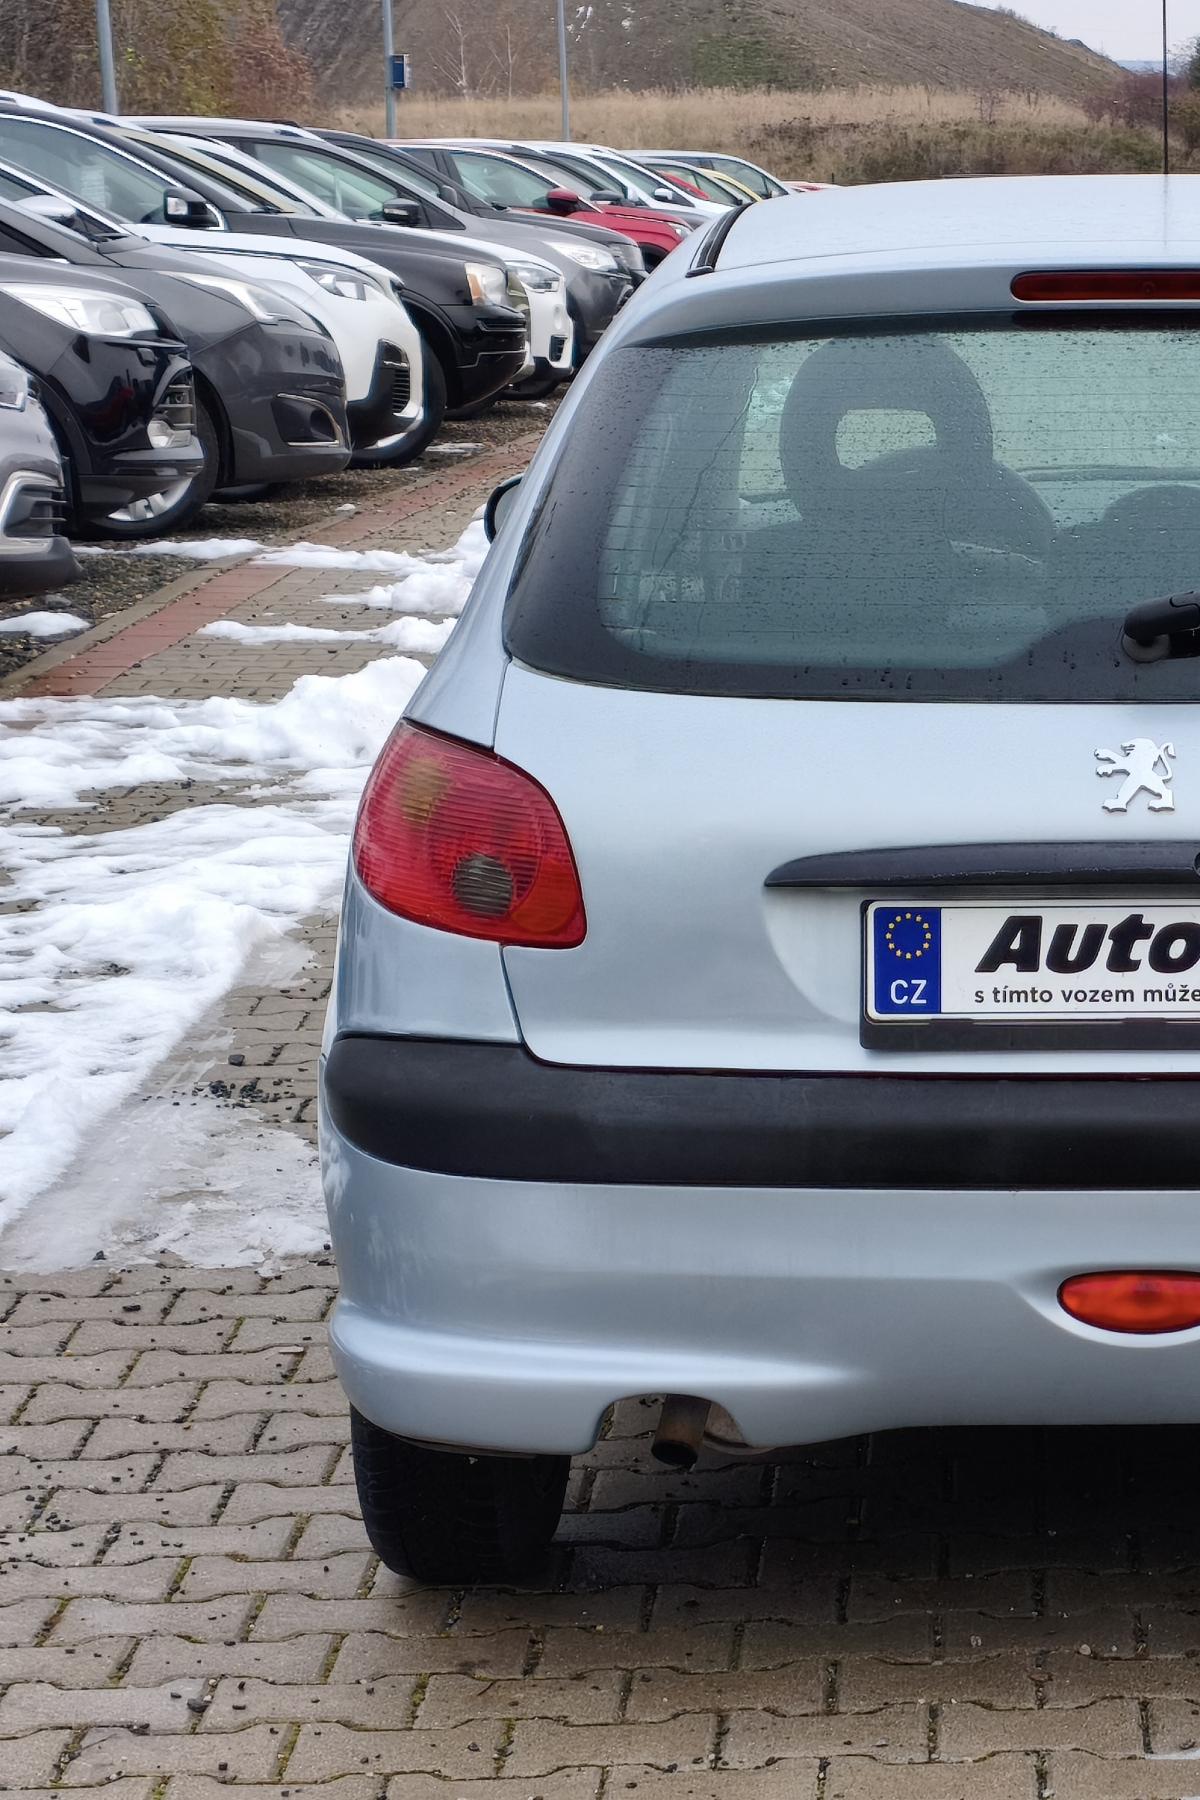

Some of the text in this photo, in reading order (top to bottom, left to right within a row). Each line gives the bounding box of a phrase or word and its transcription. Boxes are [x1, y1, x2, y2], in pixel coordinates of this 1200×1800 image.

[890, 979, 927, 1004] CZ
[975, 989, 985, 1003] s
[992, 985, 1053, 1003] tímto
[1061, 989, 1134, 1002] vozem
